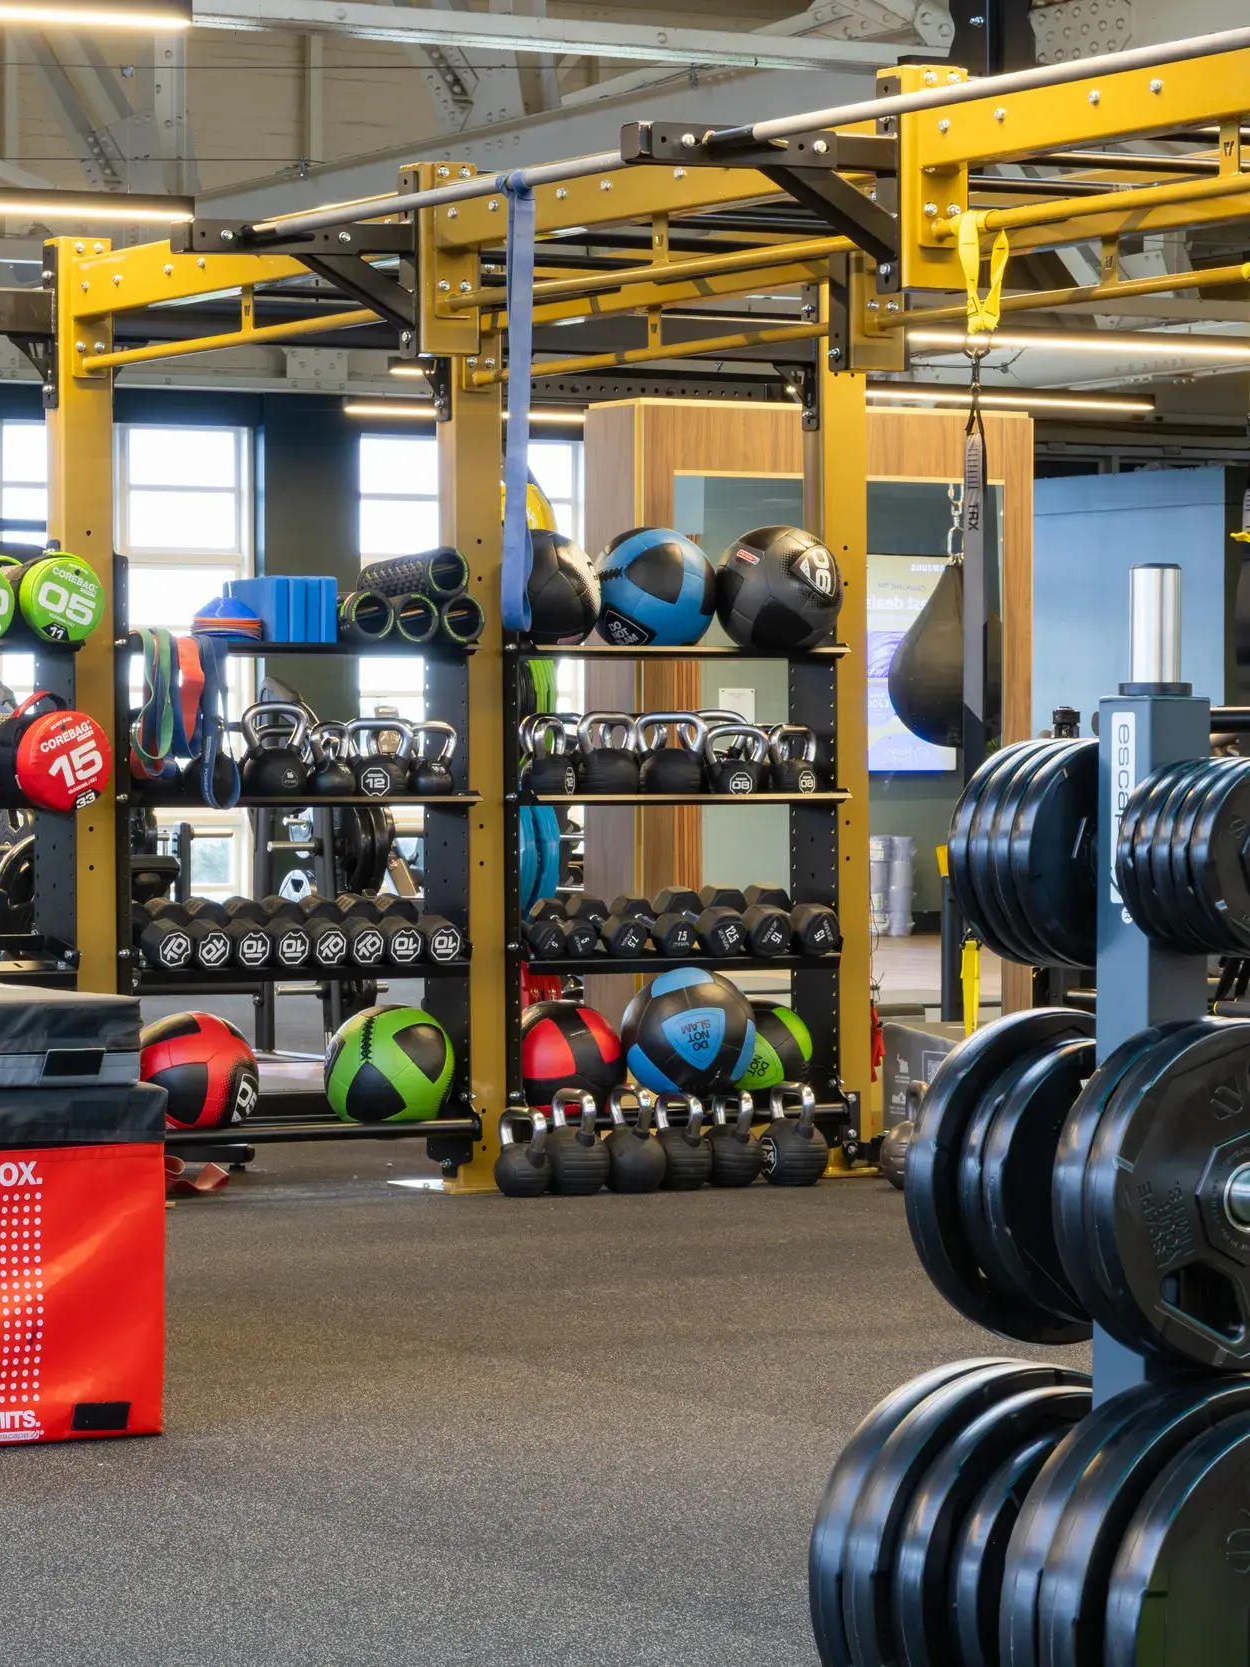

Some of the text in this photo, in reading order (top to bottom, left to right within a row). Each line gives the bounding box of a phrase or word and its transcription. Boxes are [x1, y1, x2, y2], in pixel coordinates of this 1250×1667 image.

[968, 504, 979, 531] TRX
[38, 581, 96, 626] 05
[49, 626, 64, 640] 11
[609, 621, 622, 632] DO
[612, 626, 630, 640] NOT
[48, 739, 103, 788] 15
[364, 778, 386, 789] 12
[566, 776, 574, 786] 12
[732, 780, 750, 790] 08
[800, 779, 814, 788] 08
[76, 792, 96, 809] 33
[627, 935, 640, 948] 7.5
[678, 930, 688, 941] 7.5
[724, 925, 740, 944] 12.5
[770, 930, 784, 944] 15
[814, 930, 825, 942] 15
[166, 938, 188, 960] 10
[244, 940, 267, 952] 10
[283, 939, 306, 952] 10
[322, 935, 344, 958] 10
[360, 934, 382, 957] 10
[395, 937, 418, 950] 10
[434, 936, 456, 948] 10
[552, 940, 558, 948] 5
[201, 939, 224, 960] 10
[680, 1020, 710, 1051] DO NOT SLAM
[748, 1054, 770, 1078] DO NOT
